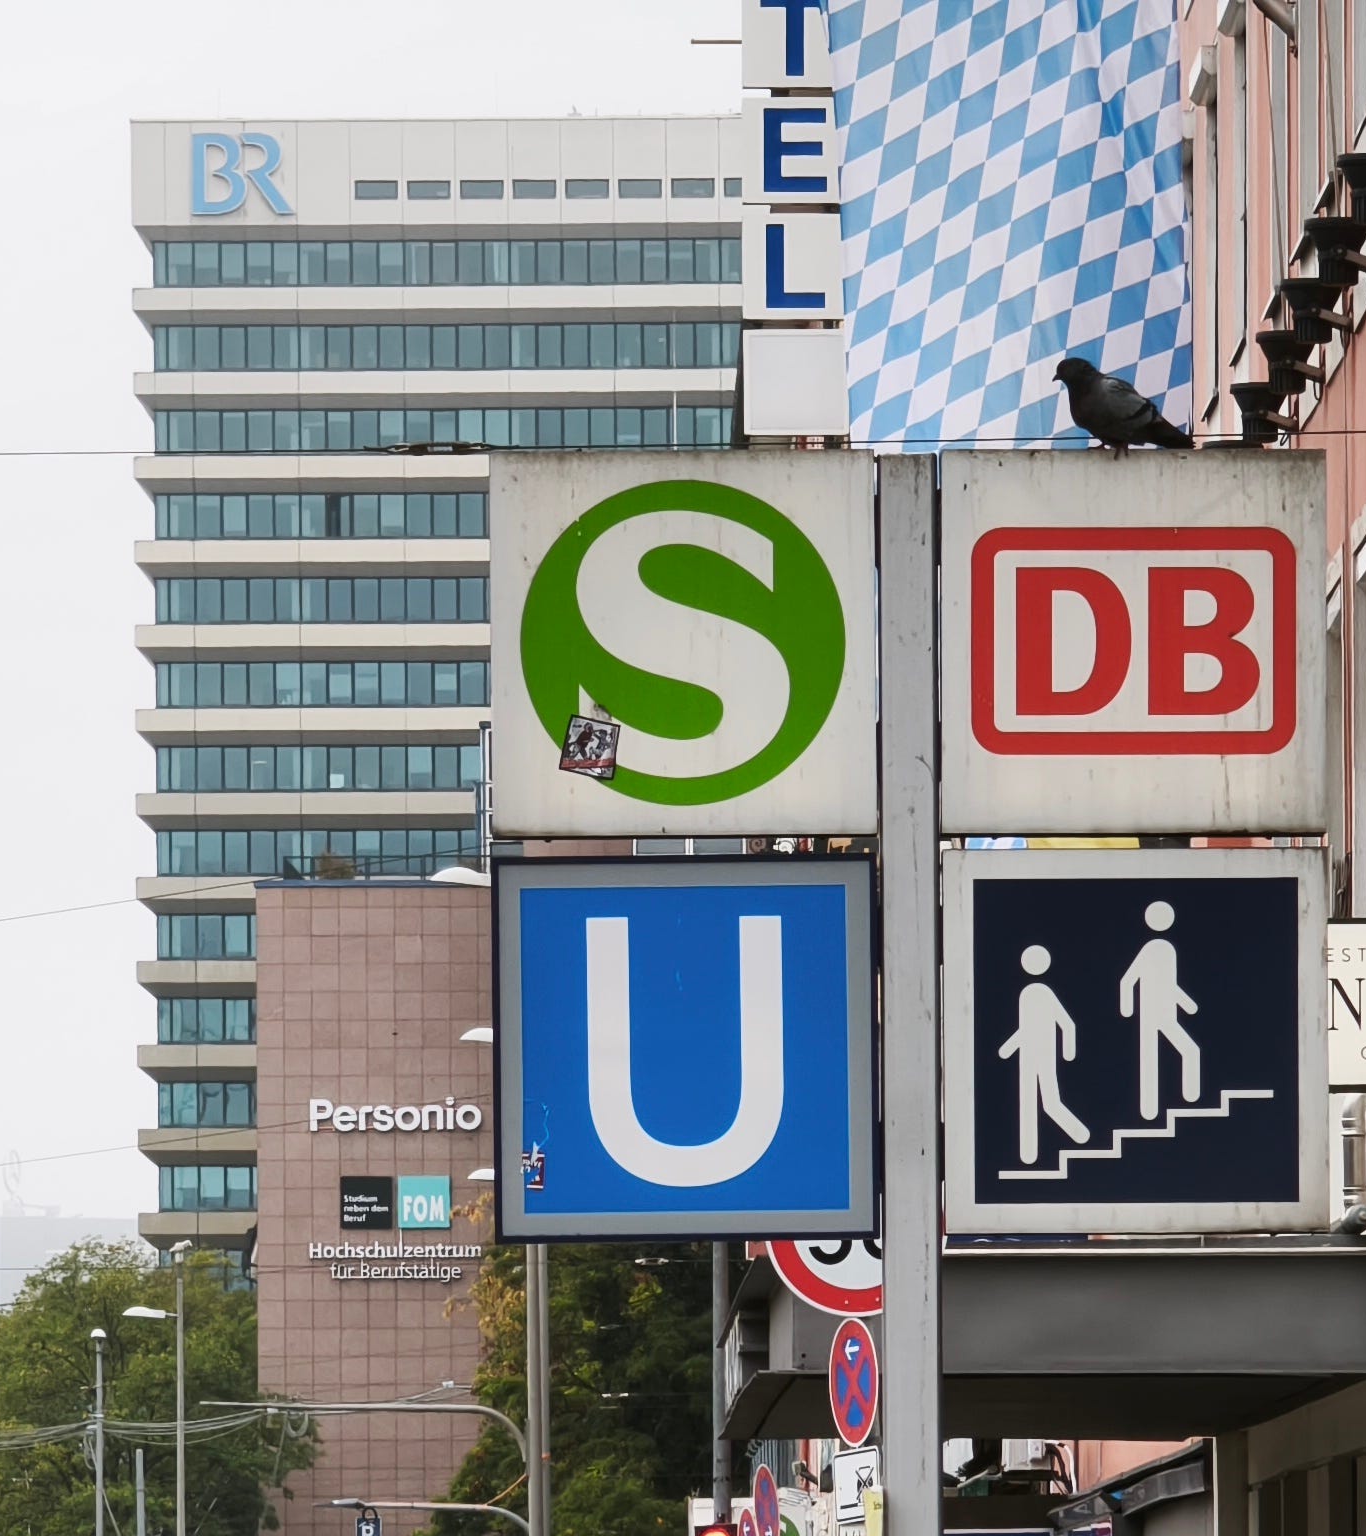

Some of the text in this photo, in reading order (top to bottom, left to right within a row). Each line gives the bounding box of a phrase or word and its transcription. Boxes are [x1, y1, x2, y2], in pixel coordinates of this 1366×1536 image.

[191, 132, 293, 215] BR
[576, 510, 790, 778] S
[1016, 567, 1261, 716] DB
[586, 916, 784, 1187] U
[309, 1096, 482, 1132] Personio
[344, 1214, 366, 1222] Beruf
[403, 1195, 444, 1222] FOM
[309, 1241, 482, 1258] Hochschulzentrum
[330, 1260, 462, 1282] für Berufstätige
